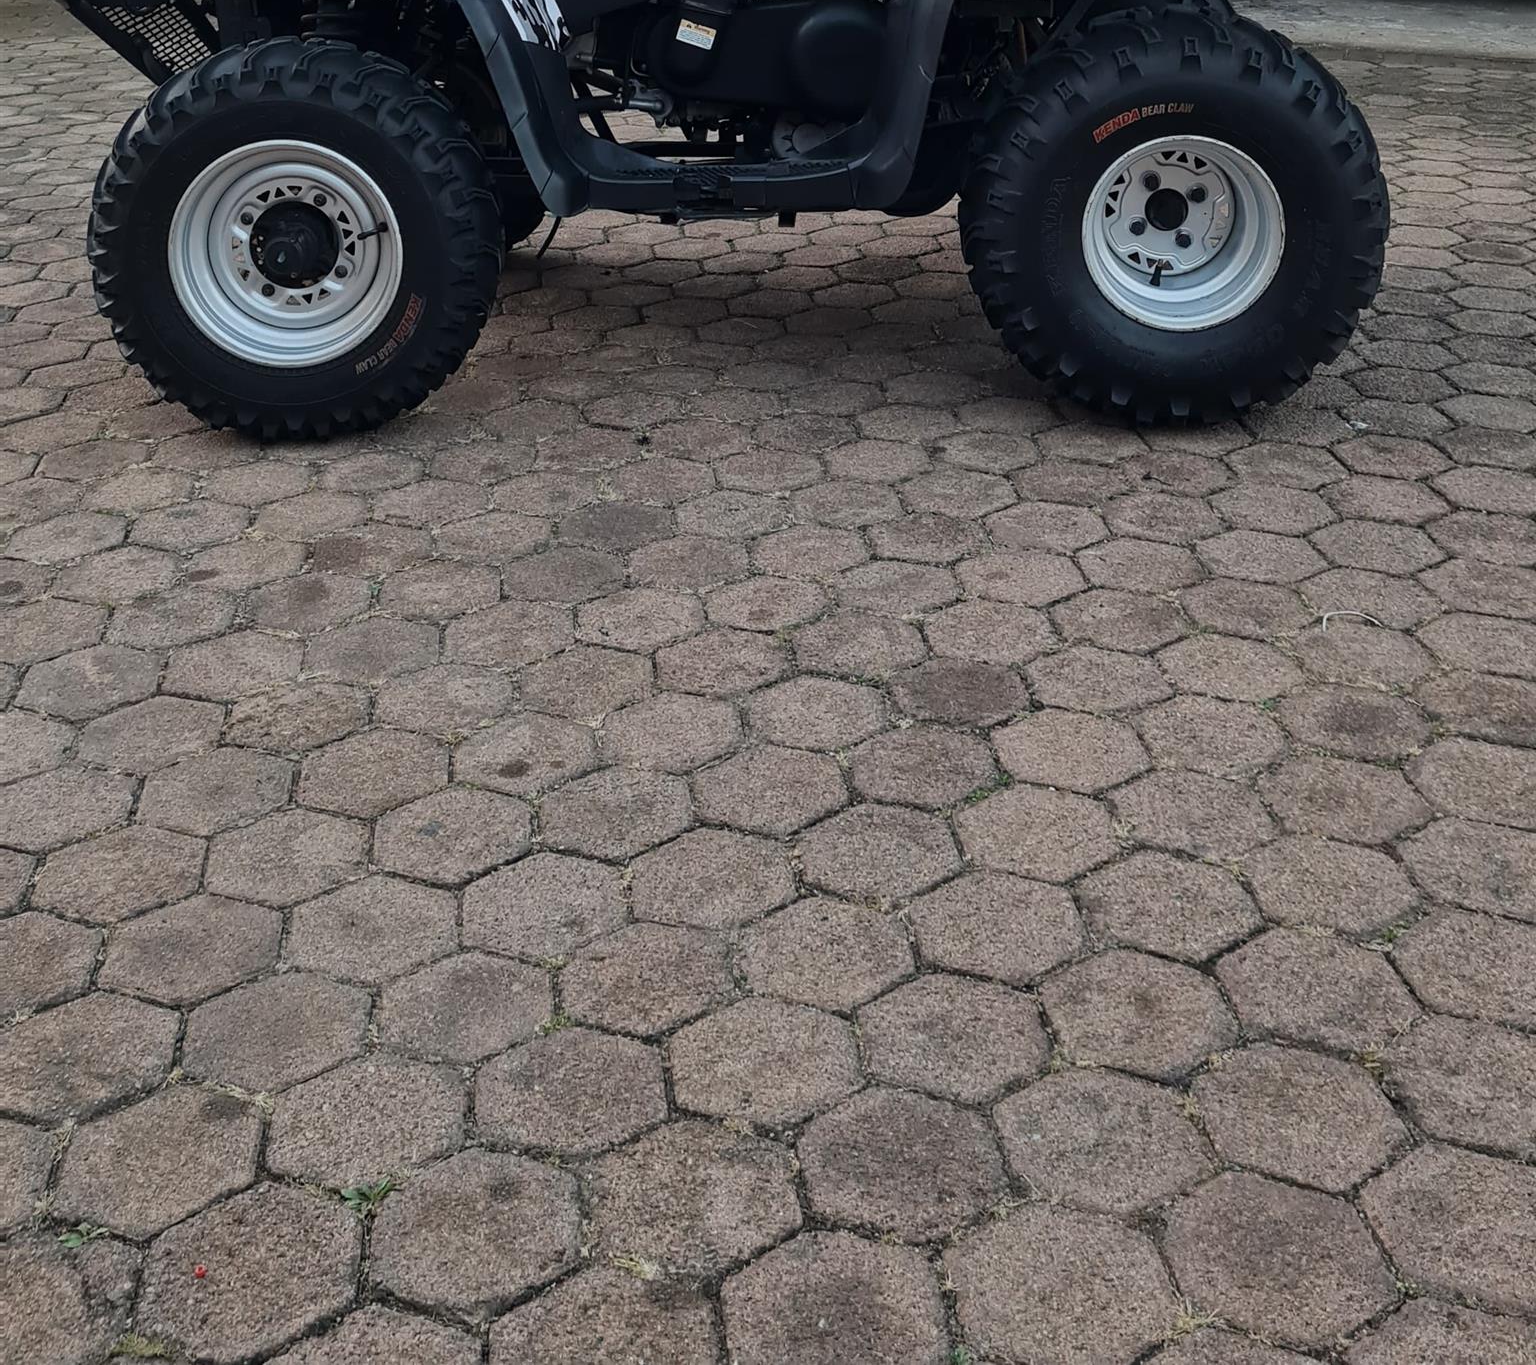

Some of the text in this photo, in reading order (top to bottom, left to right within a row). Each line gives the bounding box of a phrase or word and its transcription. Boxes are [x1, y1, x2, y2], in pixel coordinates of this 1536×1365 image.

[1092, 102, 1195, 144] KENDA BEAR CLAW
[392, 293, 422, 344] KENDA
[355, 355, 378, 375] CLAW
